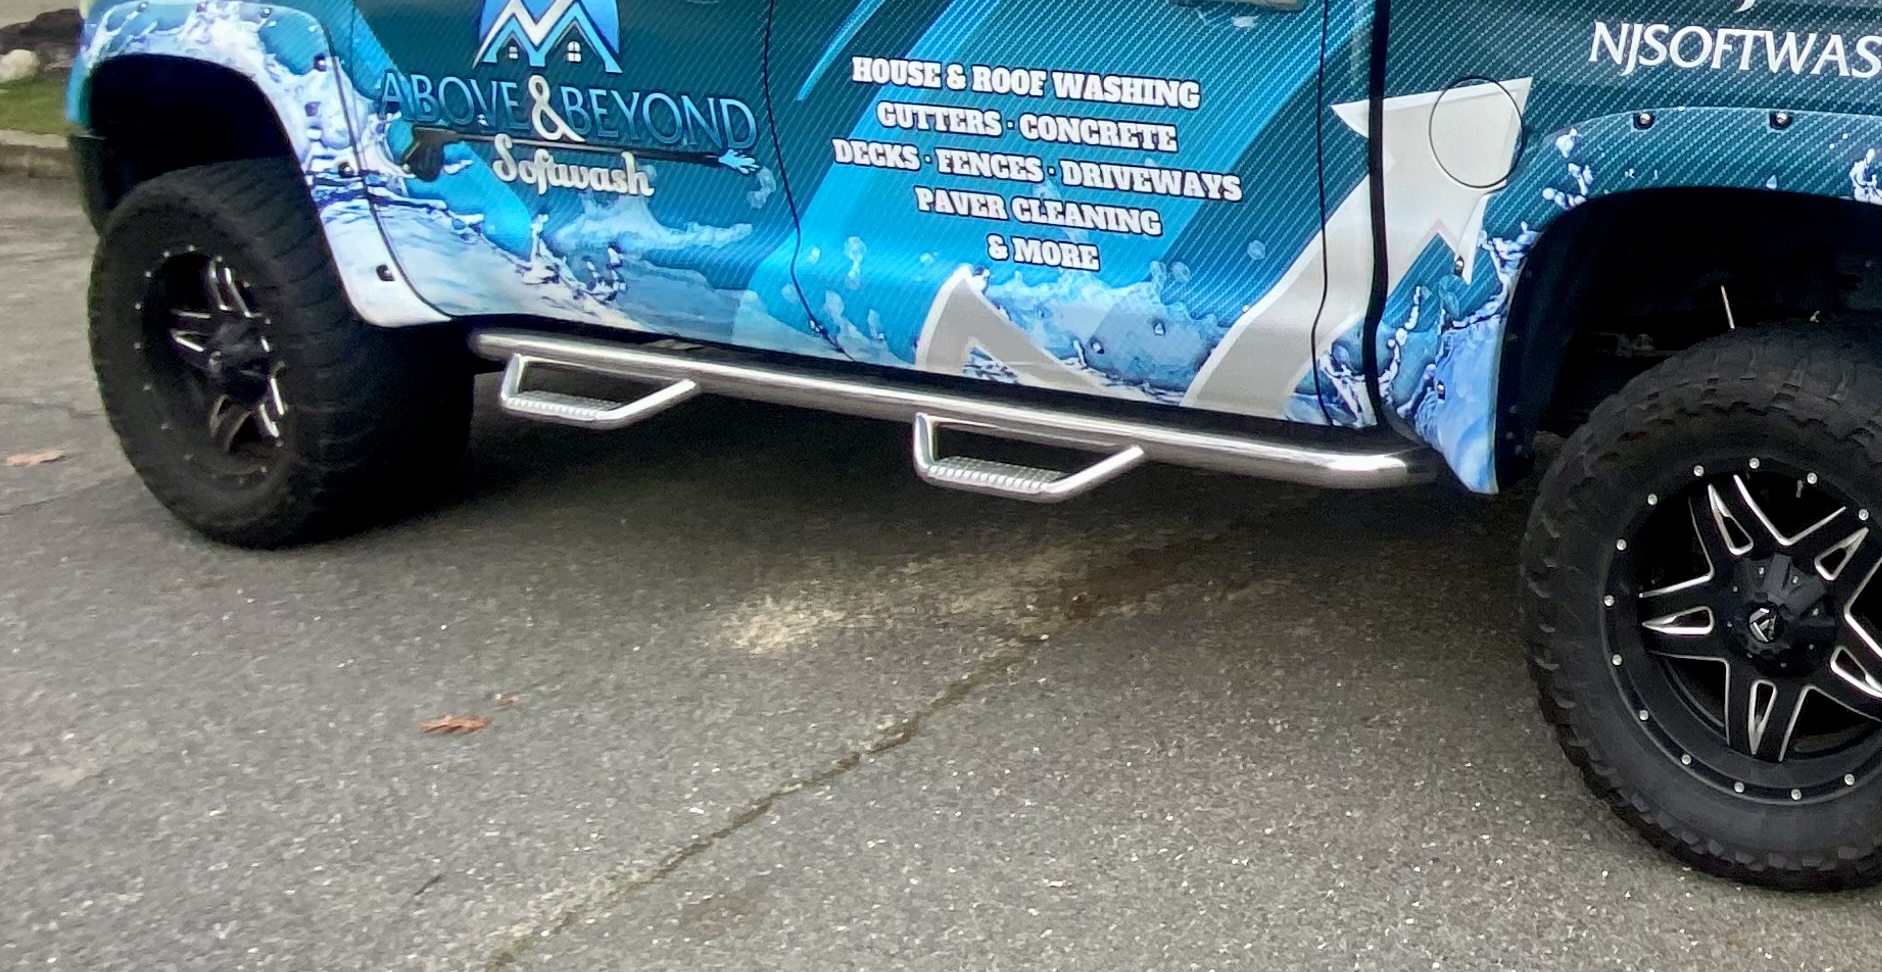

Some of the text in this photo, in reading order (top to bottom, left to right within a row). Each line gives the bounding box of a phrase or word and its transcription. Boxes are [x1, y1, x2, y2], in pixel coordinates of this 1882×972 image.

[852, 56, 1201, 109] HOUSE & ROOF WASHING
[380, 73, 759, 149] ABOVE & BEYOND
[877, 101, 1178, 152] GUTTERS CONCRETE
[492, 133, 655, 196] Softwash
[832, 139, 1243, 201] DECKS FENCES DRIVEWAYS
[915, 186, 1162, 236] PAVER CLEANING
[987, 235, 1100, 271] & MORE
